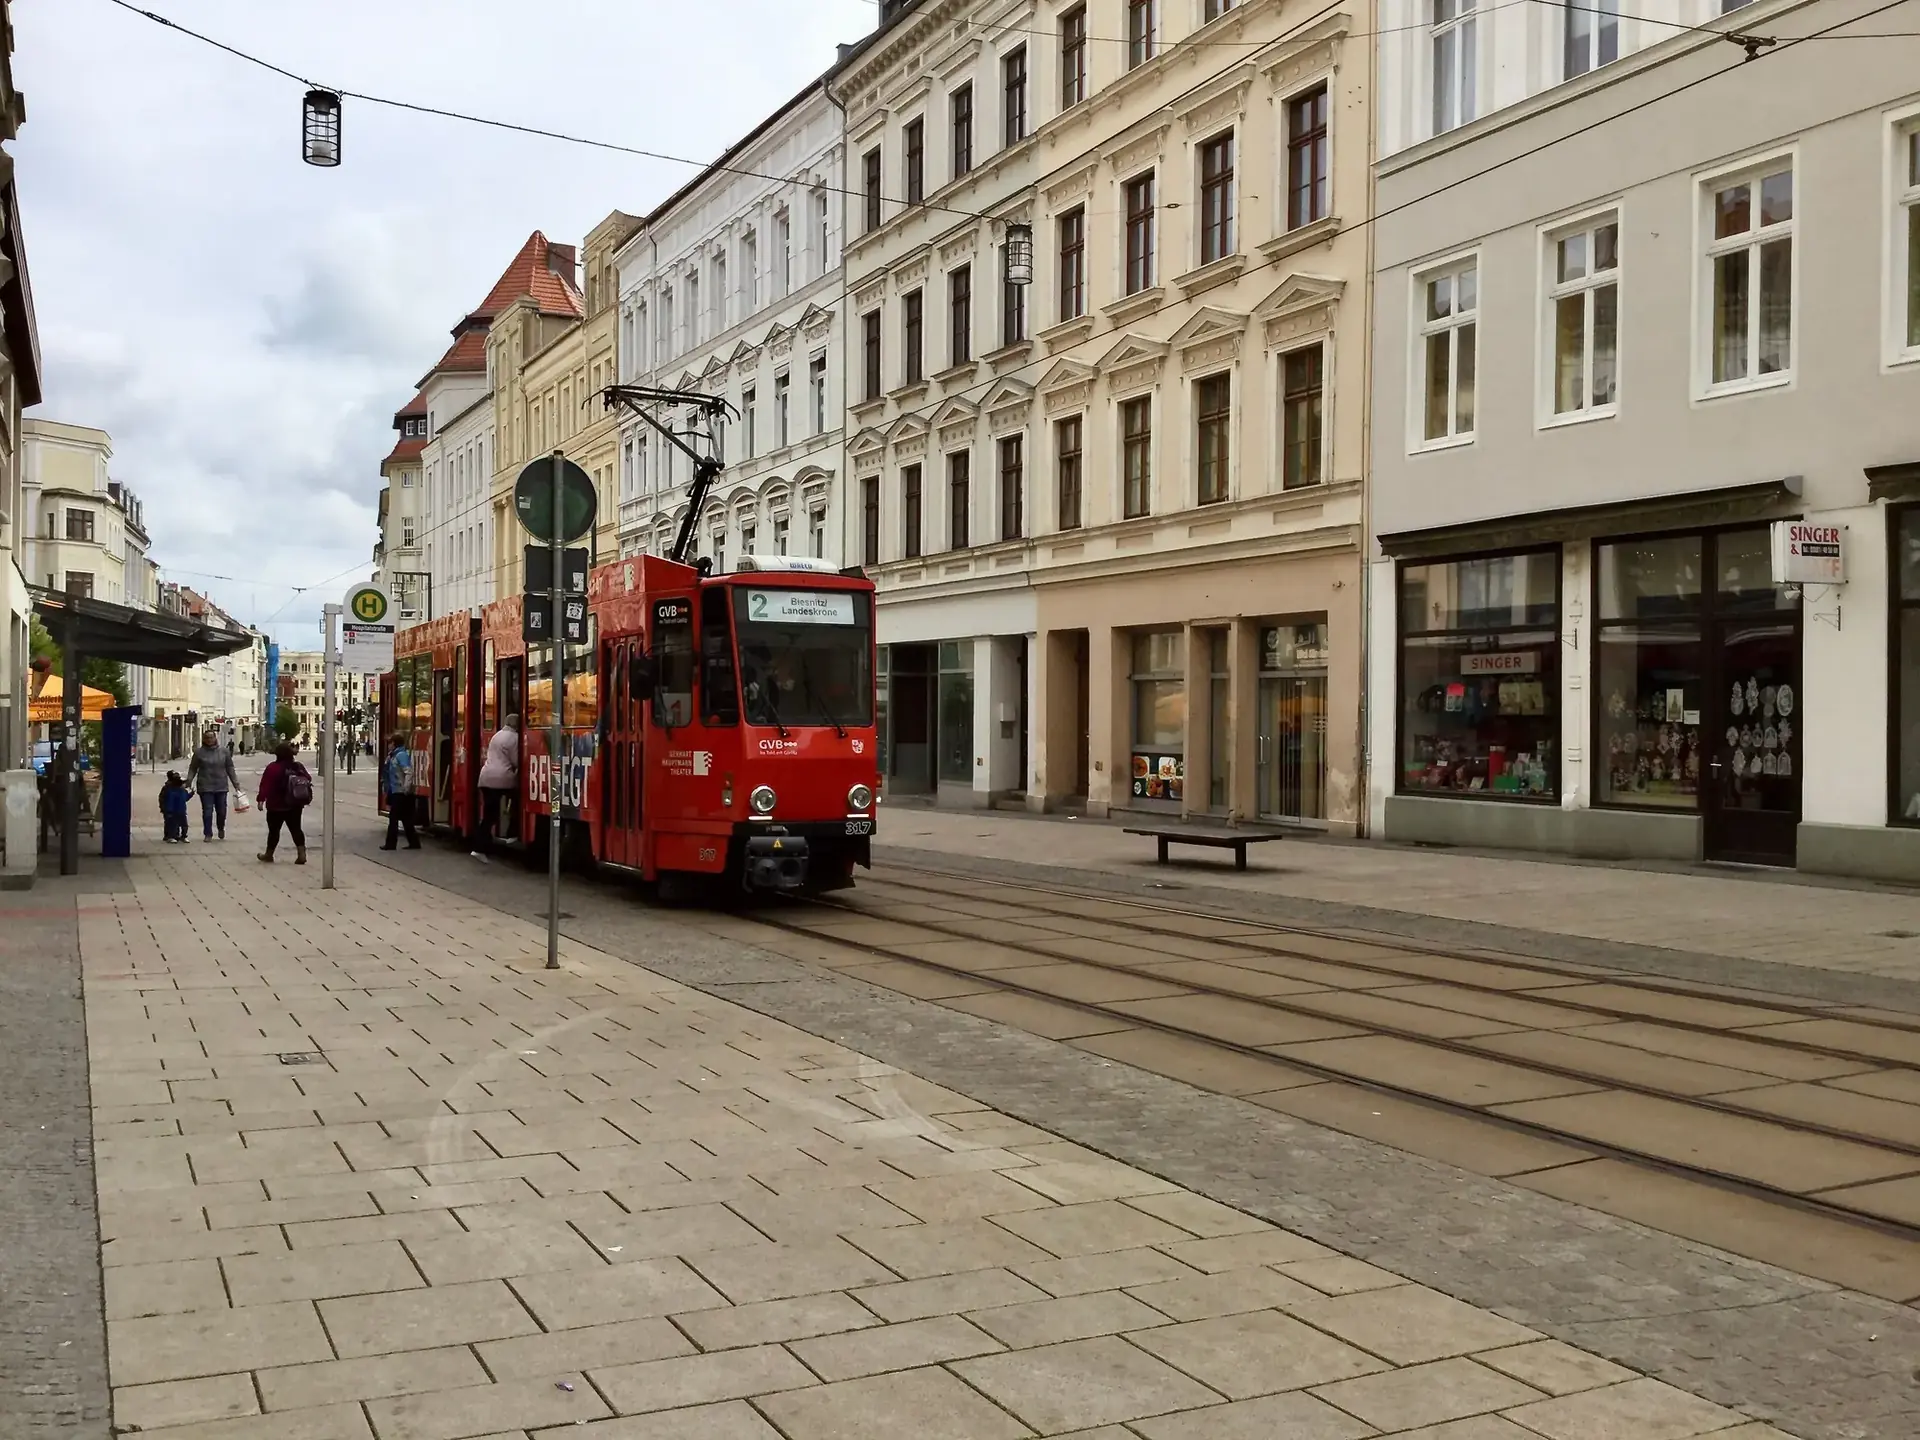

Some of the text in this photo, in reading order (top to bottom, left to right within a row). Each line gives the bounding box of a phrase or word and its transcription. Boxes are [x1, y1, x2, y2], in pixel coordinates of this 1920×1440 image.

[1790, 526, 1840, 543] SINGER
[1790, 544, 1800, 555] &
[362, 598, 377, 614] H
[658, 605, 677, 618] GVB
[751, 593, 768, 618] 2
[781, 606, 838, 617] Landeskrone
[1471, 656, 1522, 670] SINGER
[759, 740, 783, 750] GVB
[670, 768, 692, 776] THEATER
[845, 821, 872, 835] 317
[698, 848, 717, 862] 317
